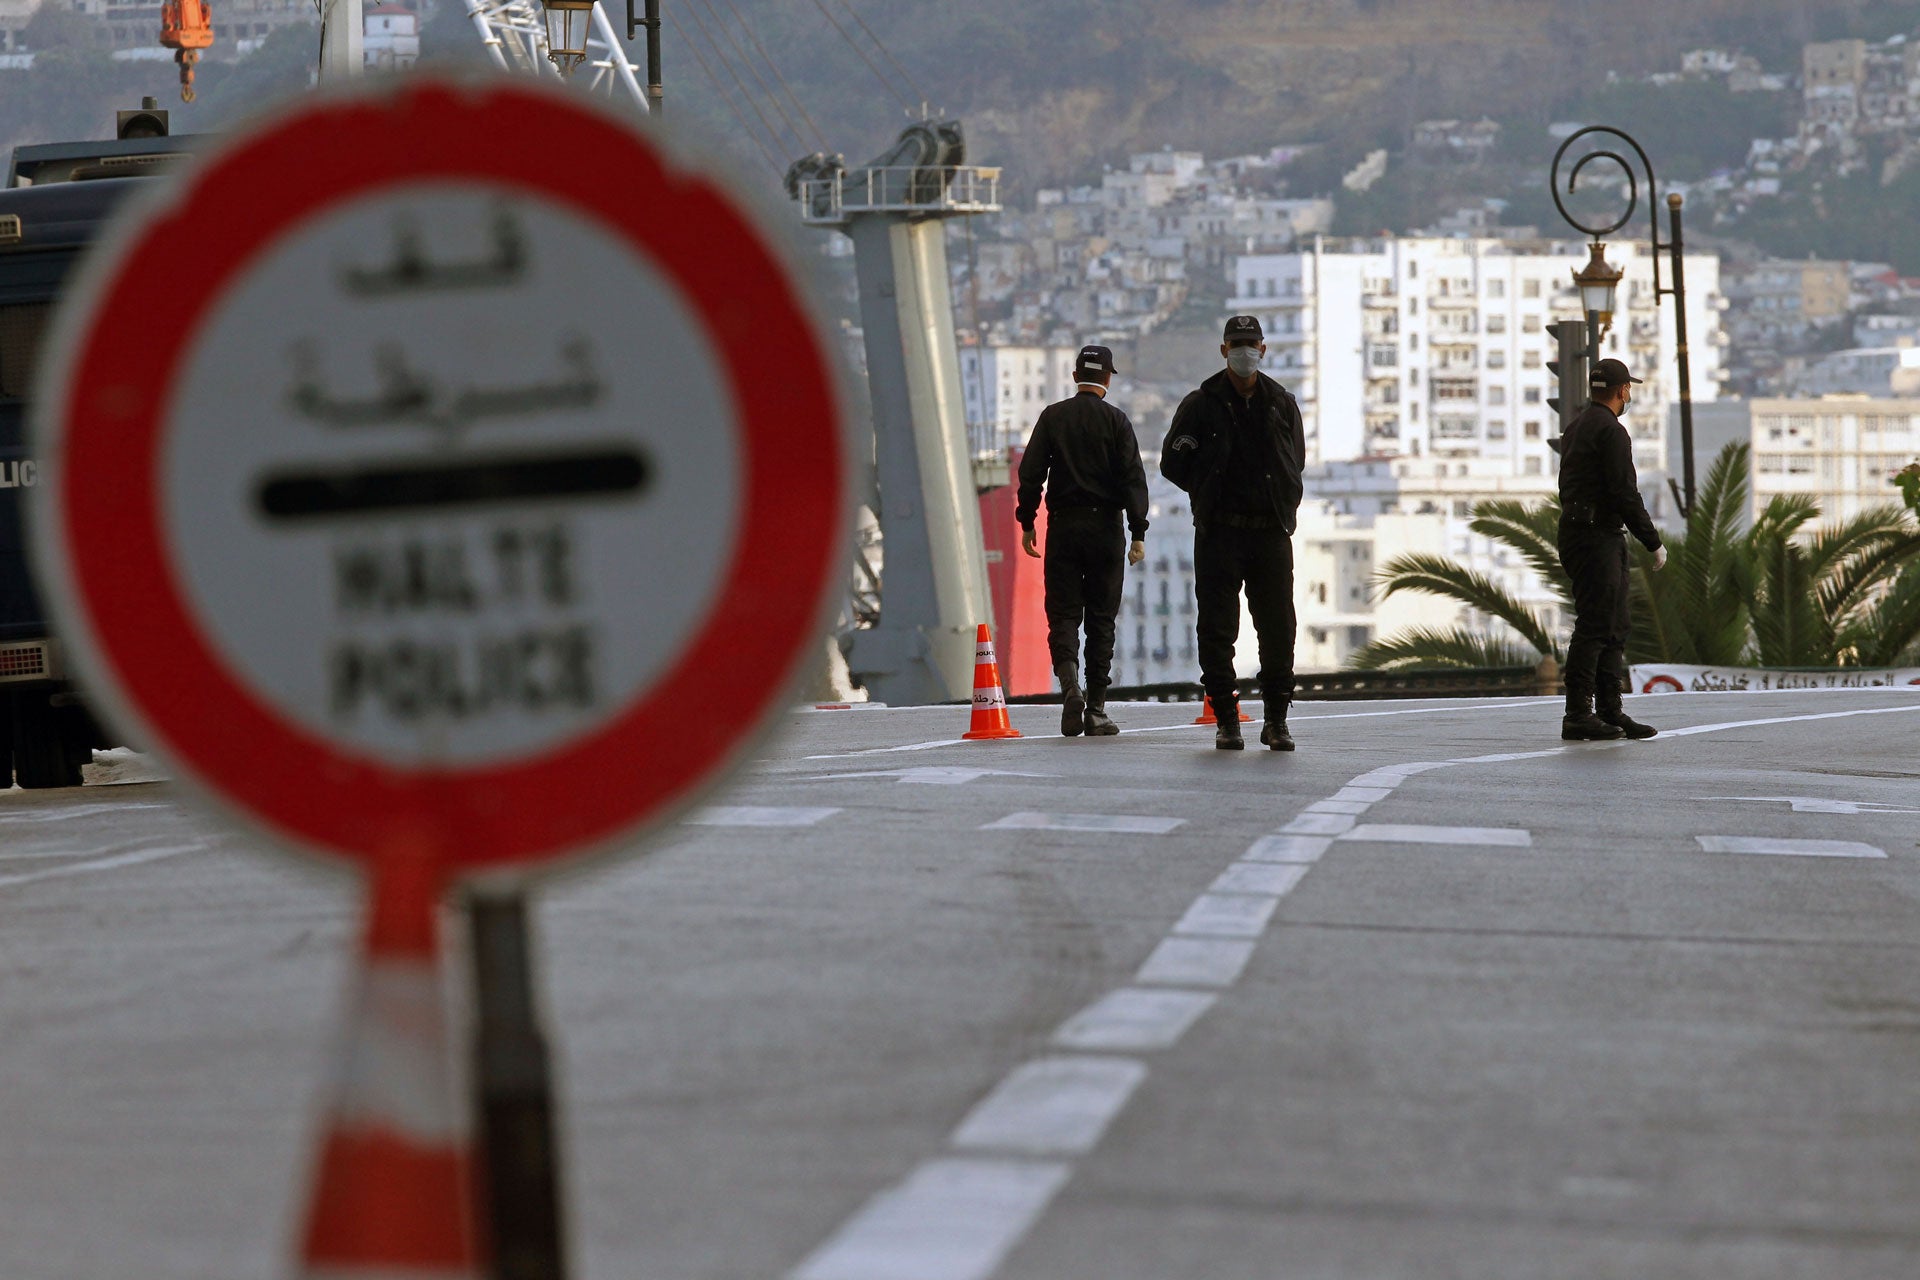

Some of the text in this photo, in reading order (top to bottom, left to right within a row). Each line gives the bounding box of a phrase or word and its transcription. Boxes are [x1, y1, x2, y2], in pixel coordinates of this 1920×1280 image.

[0, 460, 43, 488] LIC
[334, 525, 574, 614] HALTE
[330, 627, 596, 722] POLICE
[974, 694, 1002, 705] شرطة
